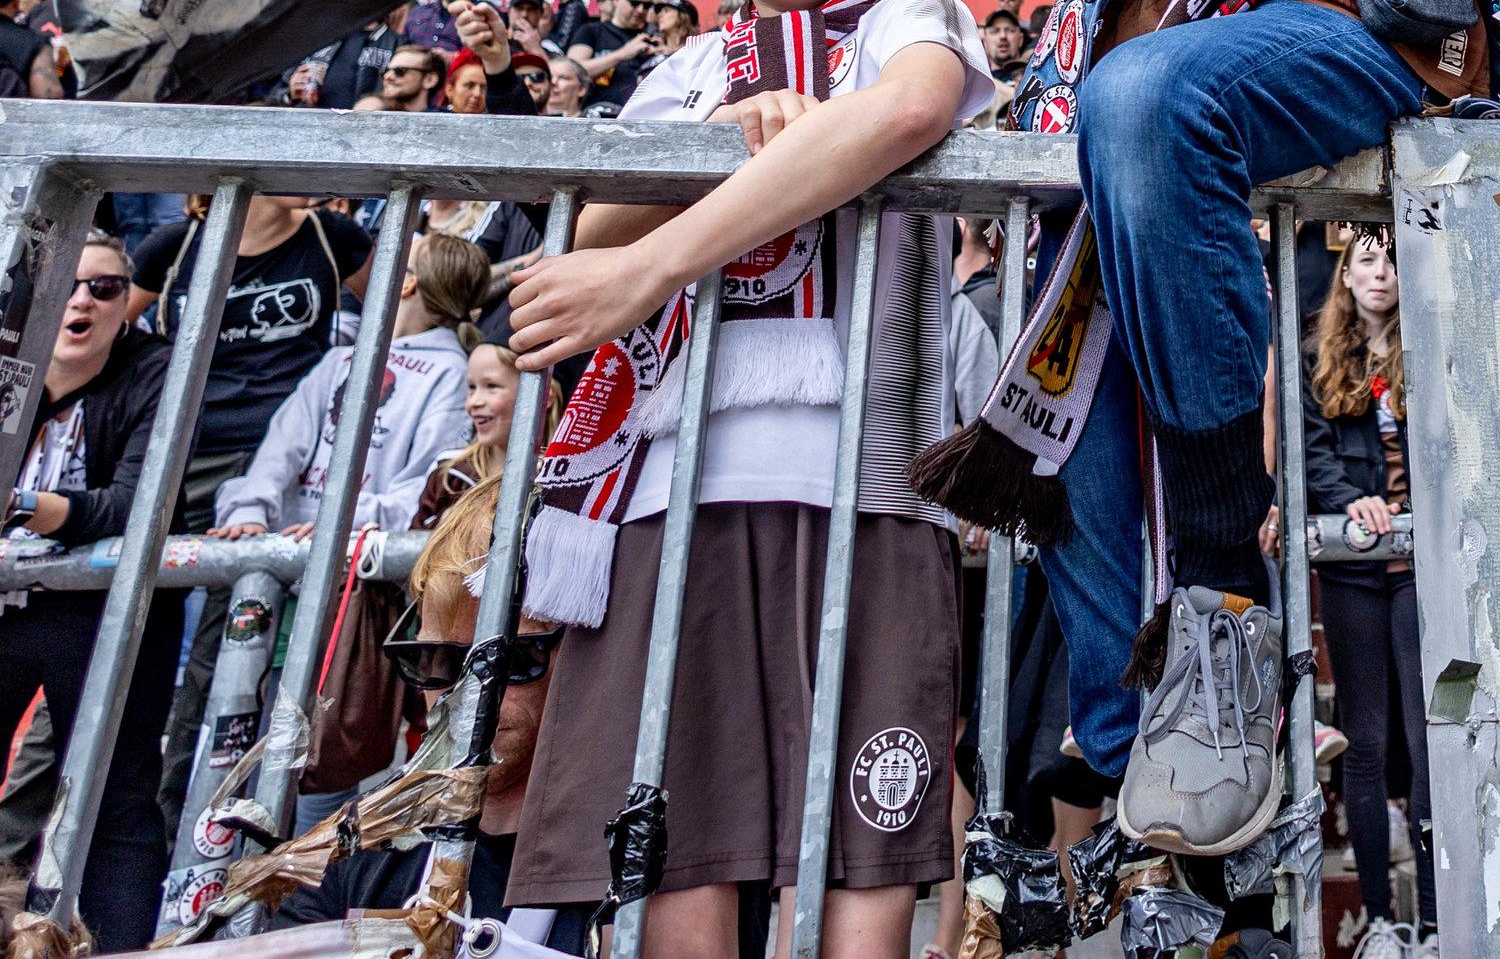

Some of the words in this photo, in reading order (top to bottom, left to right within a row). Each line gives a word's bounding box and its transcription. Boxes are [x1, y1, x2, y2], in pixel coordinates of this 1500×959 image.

[856, 755, 872, 777] FC
[871, 735, 894, 755] ST.
[898, 732, 928, 776] PAULI
[876, 809, 907, 827] 1910
